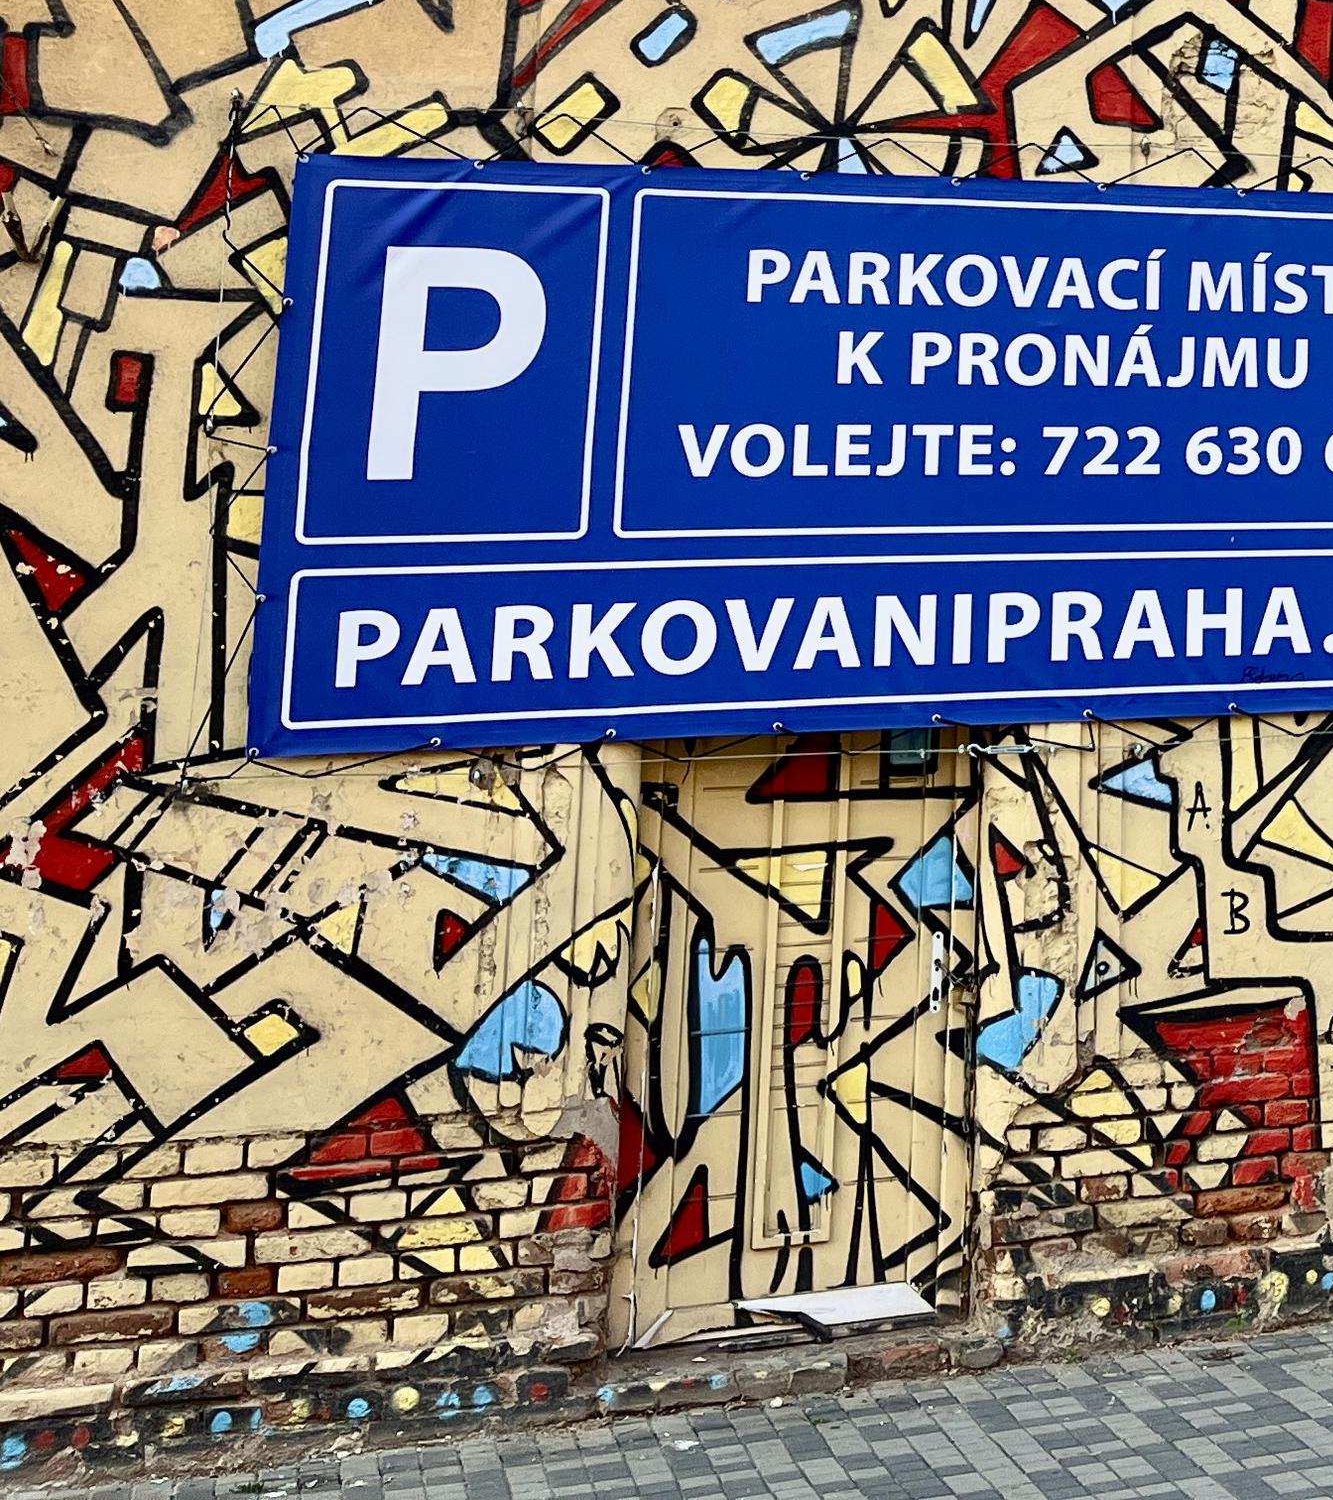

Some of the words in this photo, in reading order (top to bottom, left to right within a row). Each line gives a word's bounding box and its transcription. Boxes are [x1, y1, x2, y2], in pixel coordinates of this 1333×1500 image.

[746, 248, 1167, 311] PARKOVACÍ
[367, 246, 547, 481] P
[836, 330, 885, 385] K
[910, 324, 1309, 389] PRONÁJMU
[677, 424, 1017, 478] VOLEJTE:
[1042, 425, 1161, 475] 722
[1185, 426, 1302, 476] 630
[1221, 889, 1251, 935] B
